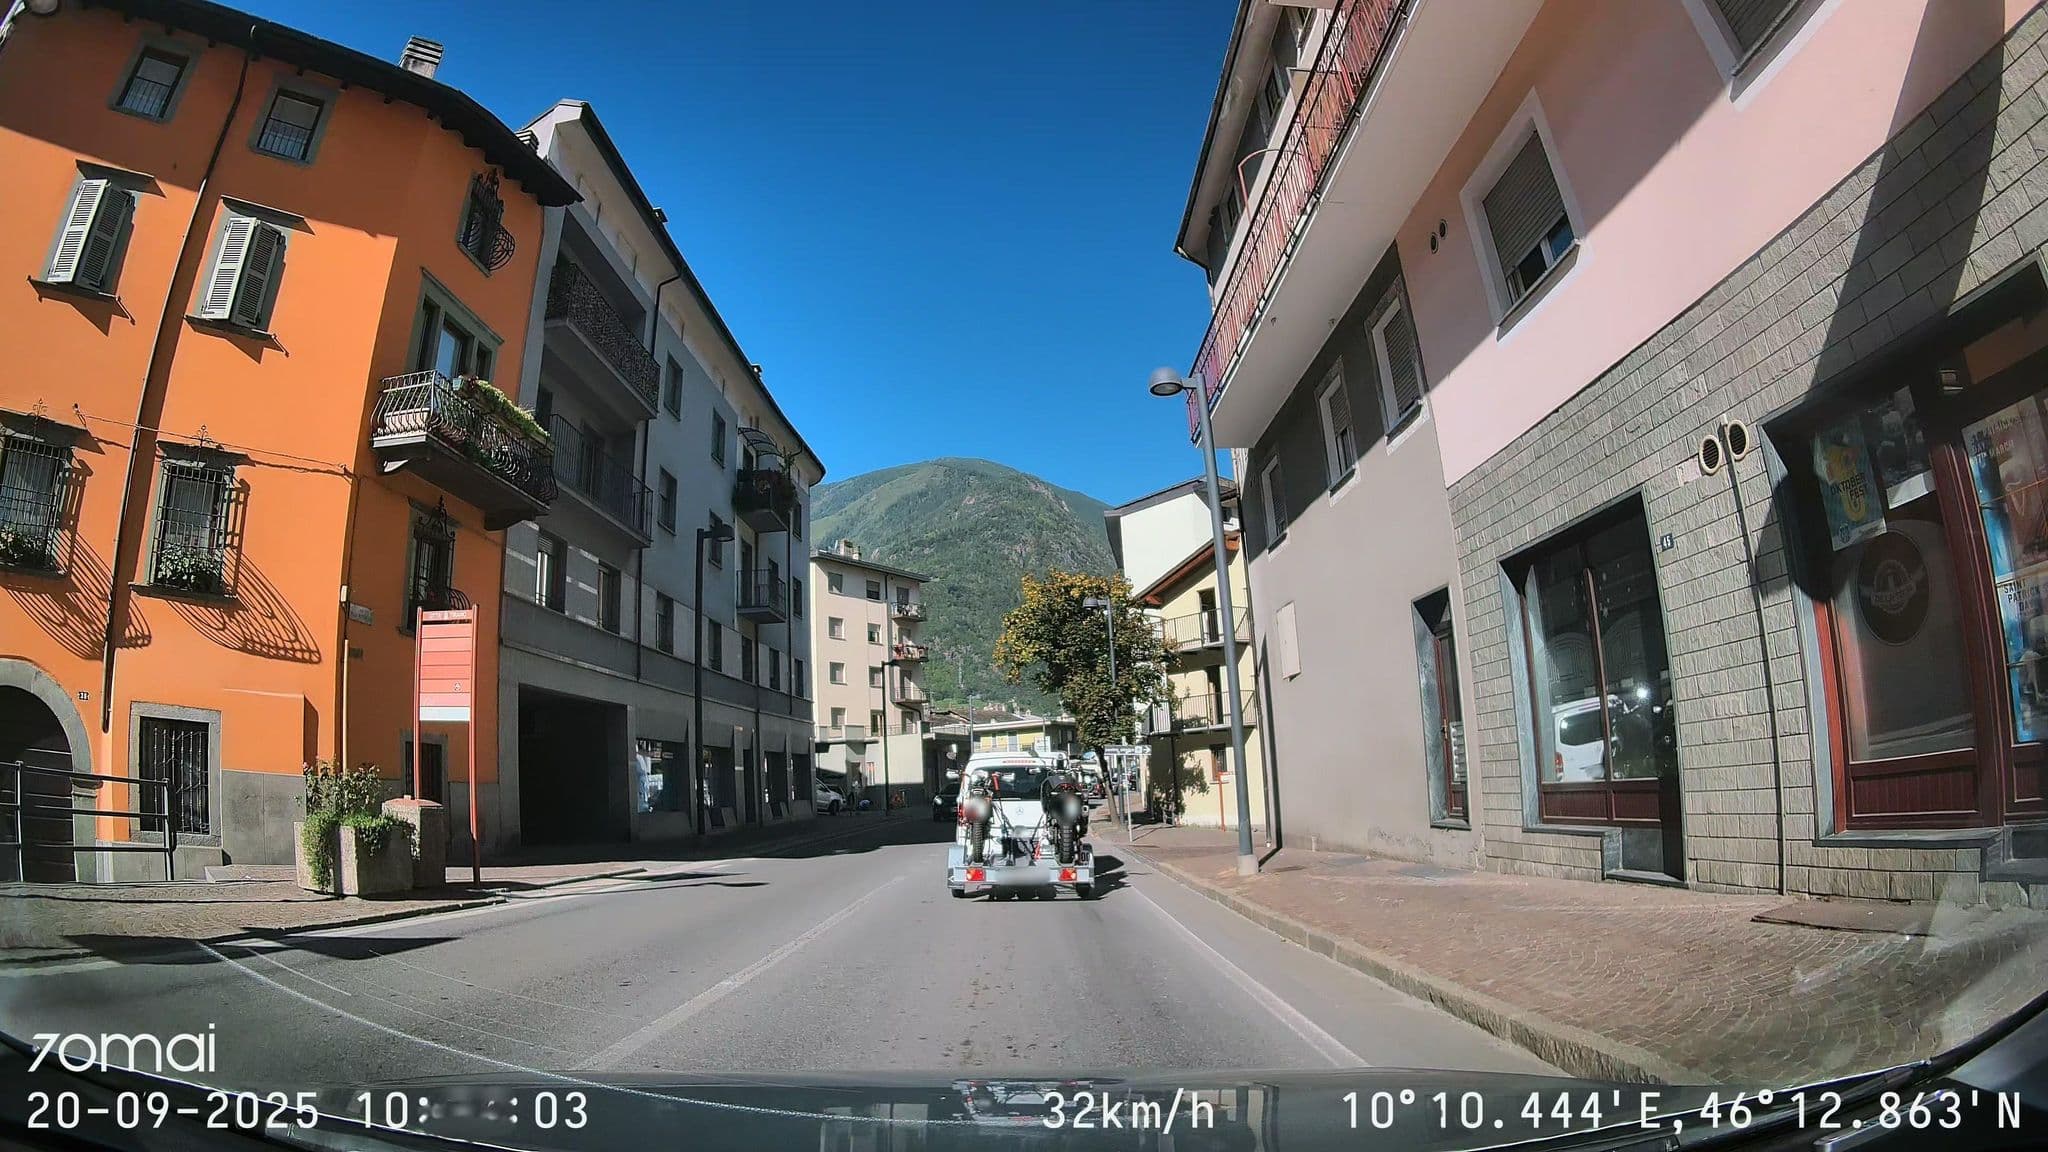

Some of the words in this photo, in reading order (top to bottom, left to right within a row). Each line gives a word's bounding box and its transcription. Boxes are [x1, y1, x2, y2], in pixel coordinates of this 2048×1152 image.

[1830, 471, 1870, 496] OKTOBER
[1848, 482, 1869, 500] FEST
[2003, 577, 2026, 594] SAINT
